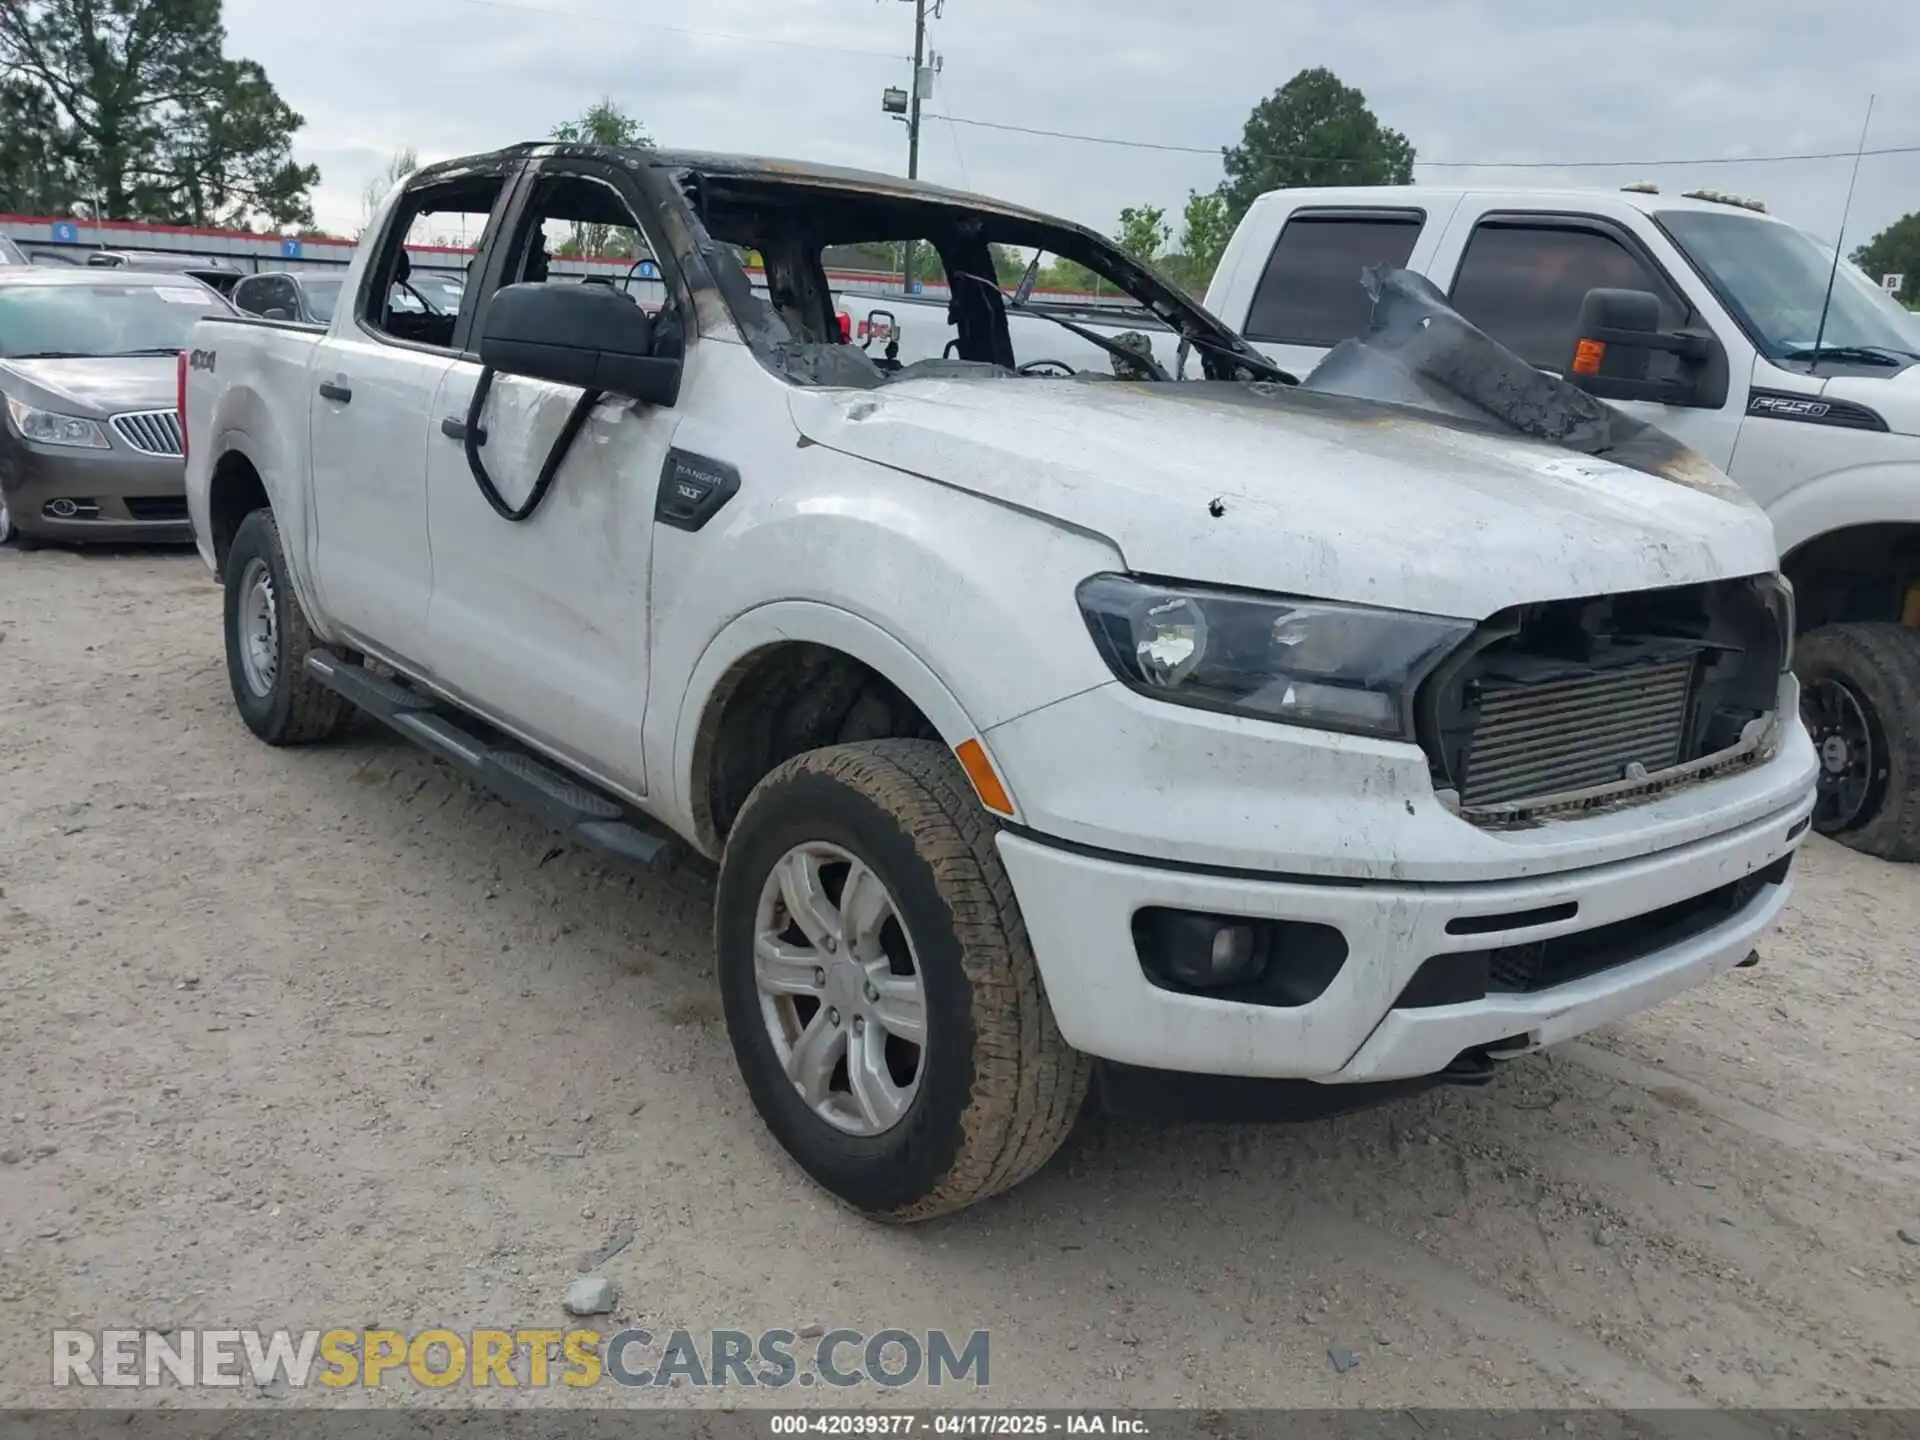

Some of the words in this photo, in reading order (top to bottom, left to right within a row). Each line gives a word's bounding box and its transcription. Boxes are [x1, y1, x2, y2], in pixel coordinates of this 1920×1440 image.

[1750, 397, 1831, 417] F250
[675, 463, 722, 485] RANGER
[677, 484, 703, 500] XLT
